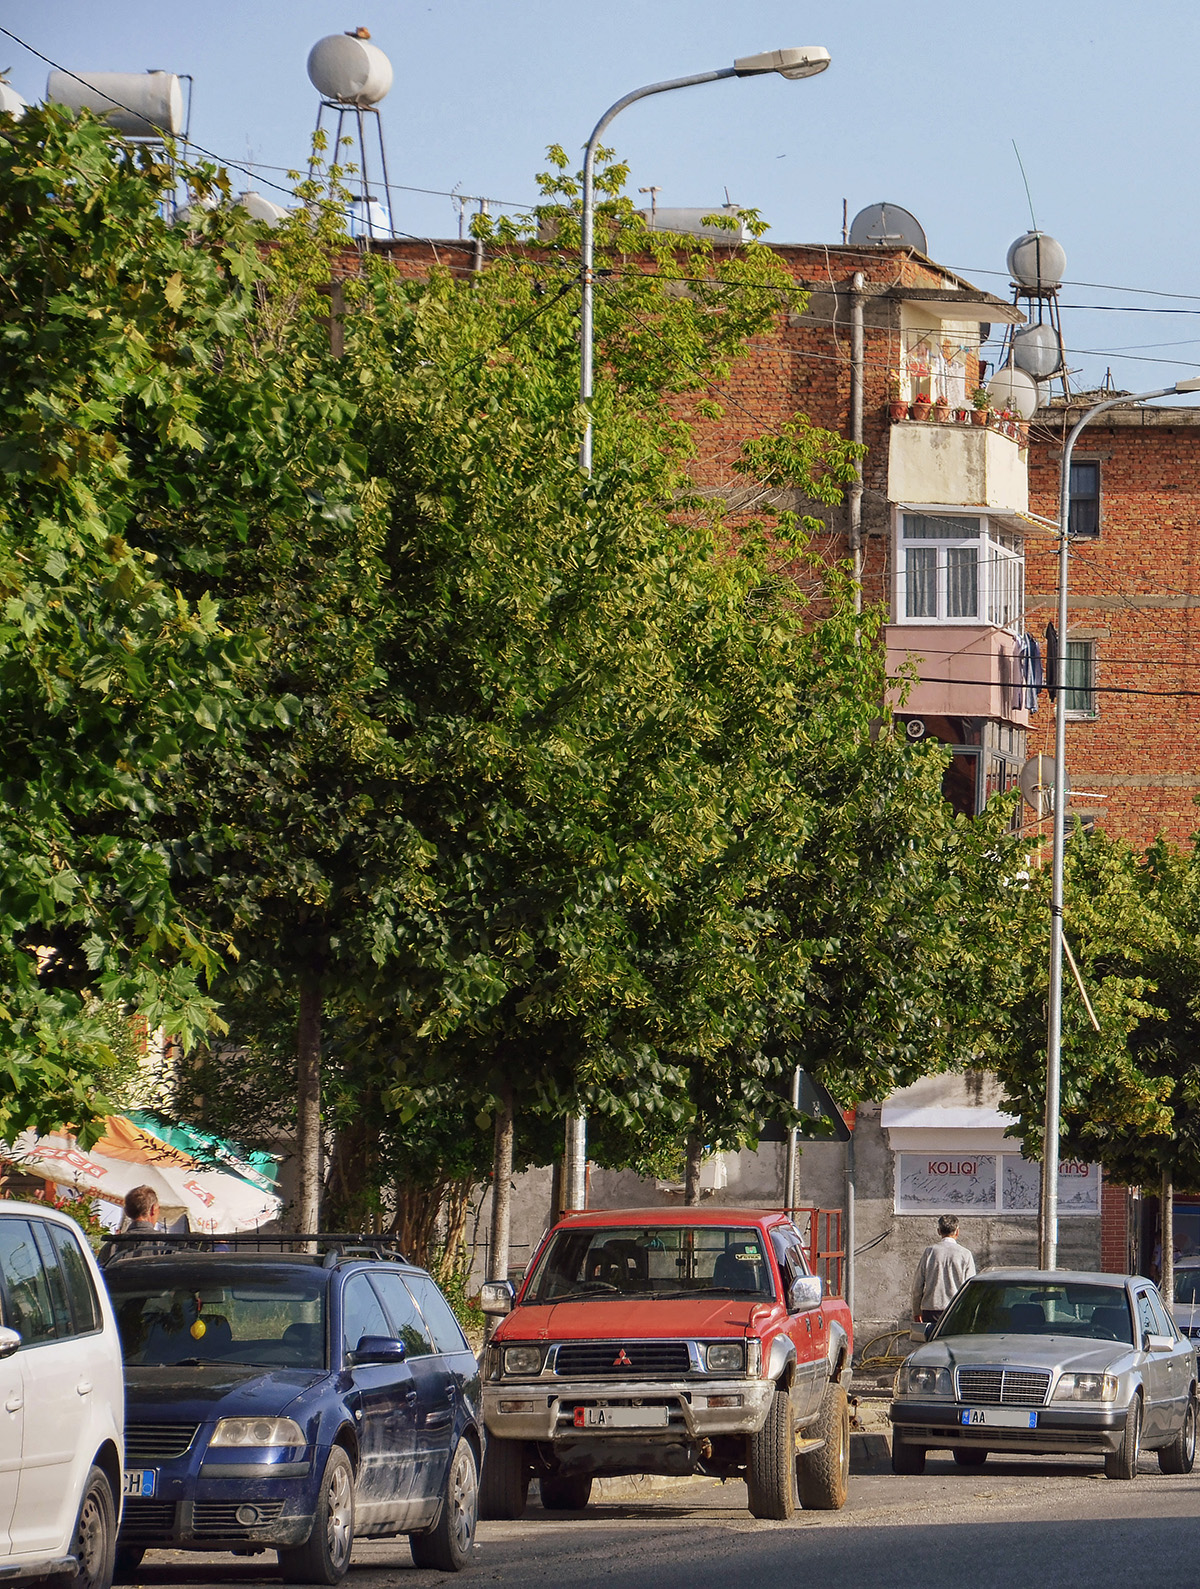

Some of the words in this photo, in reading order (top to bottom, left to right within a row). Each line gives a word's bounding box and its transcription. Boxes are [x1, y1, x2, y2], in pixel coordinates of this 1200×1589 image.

[928, 1161, 977, 1175] KOLIQI
[589, 1409, 605, 1425] LA
[972, 1411, 986, 1424] AA
